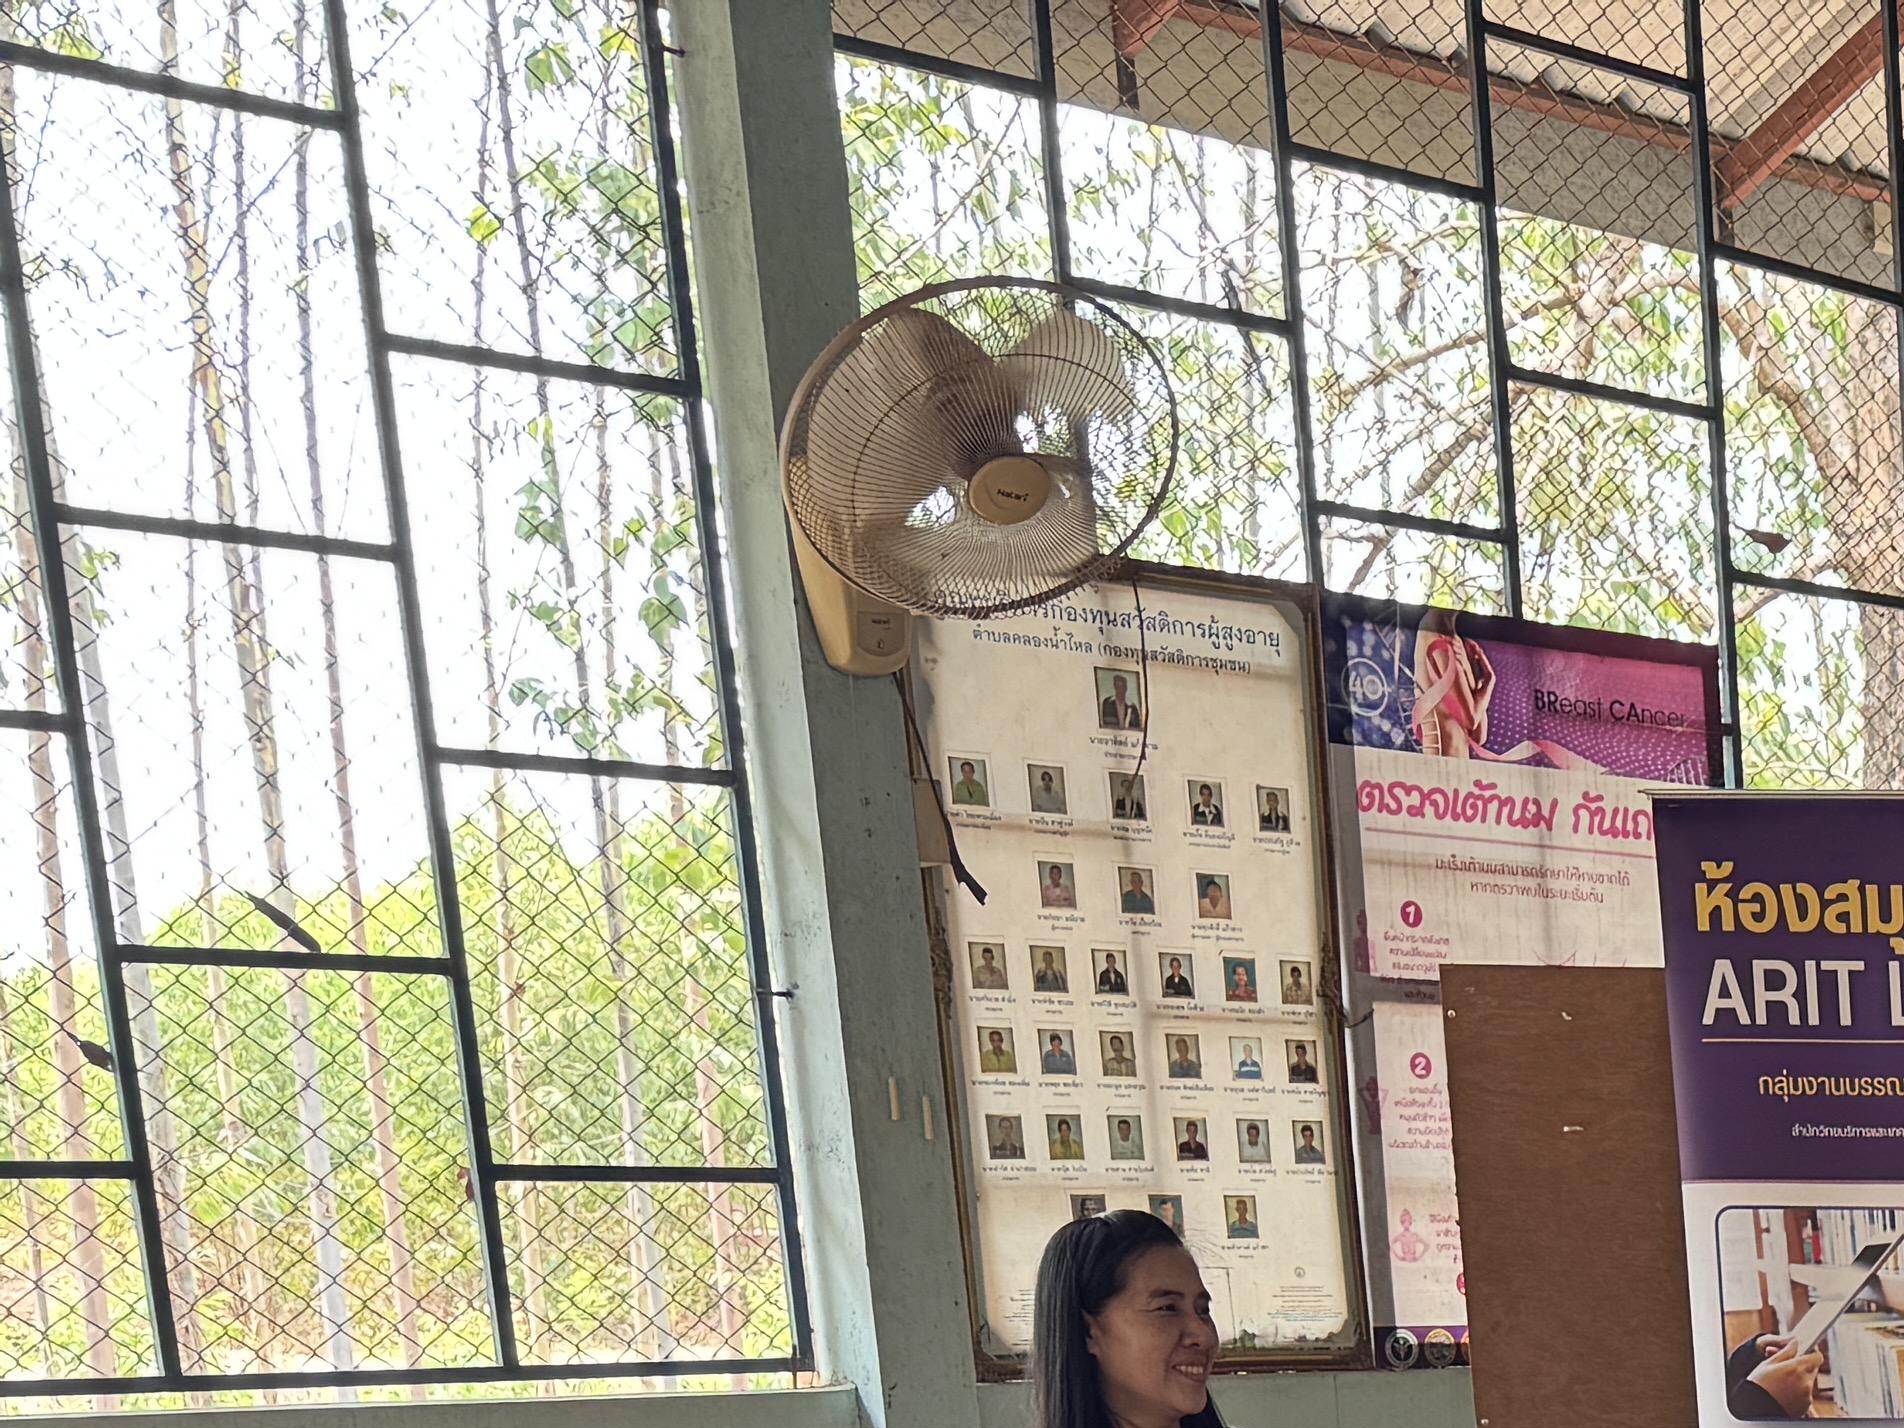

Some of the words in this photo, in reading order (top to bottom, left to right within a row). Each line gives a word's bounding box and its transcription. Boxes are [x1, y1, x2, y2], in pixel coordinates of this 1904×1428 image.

[1357, 778, 1558, 832] ตรวจเต้านม
[1701, 959, 1865, 1027] ARIT
